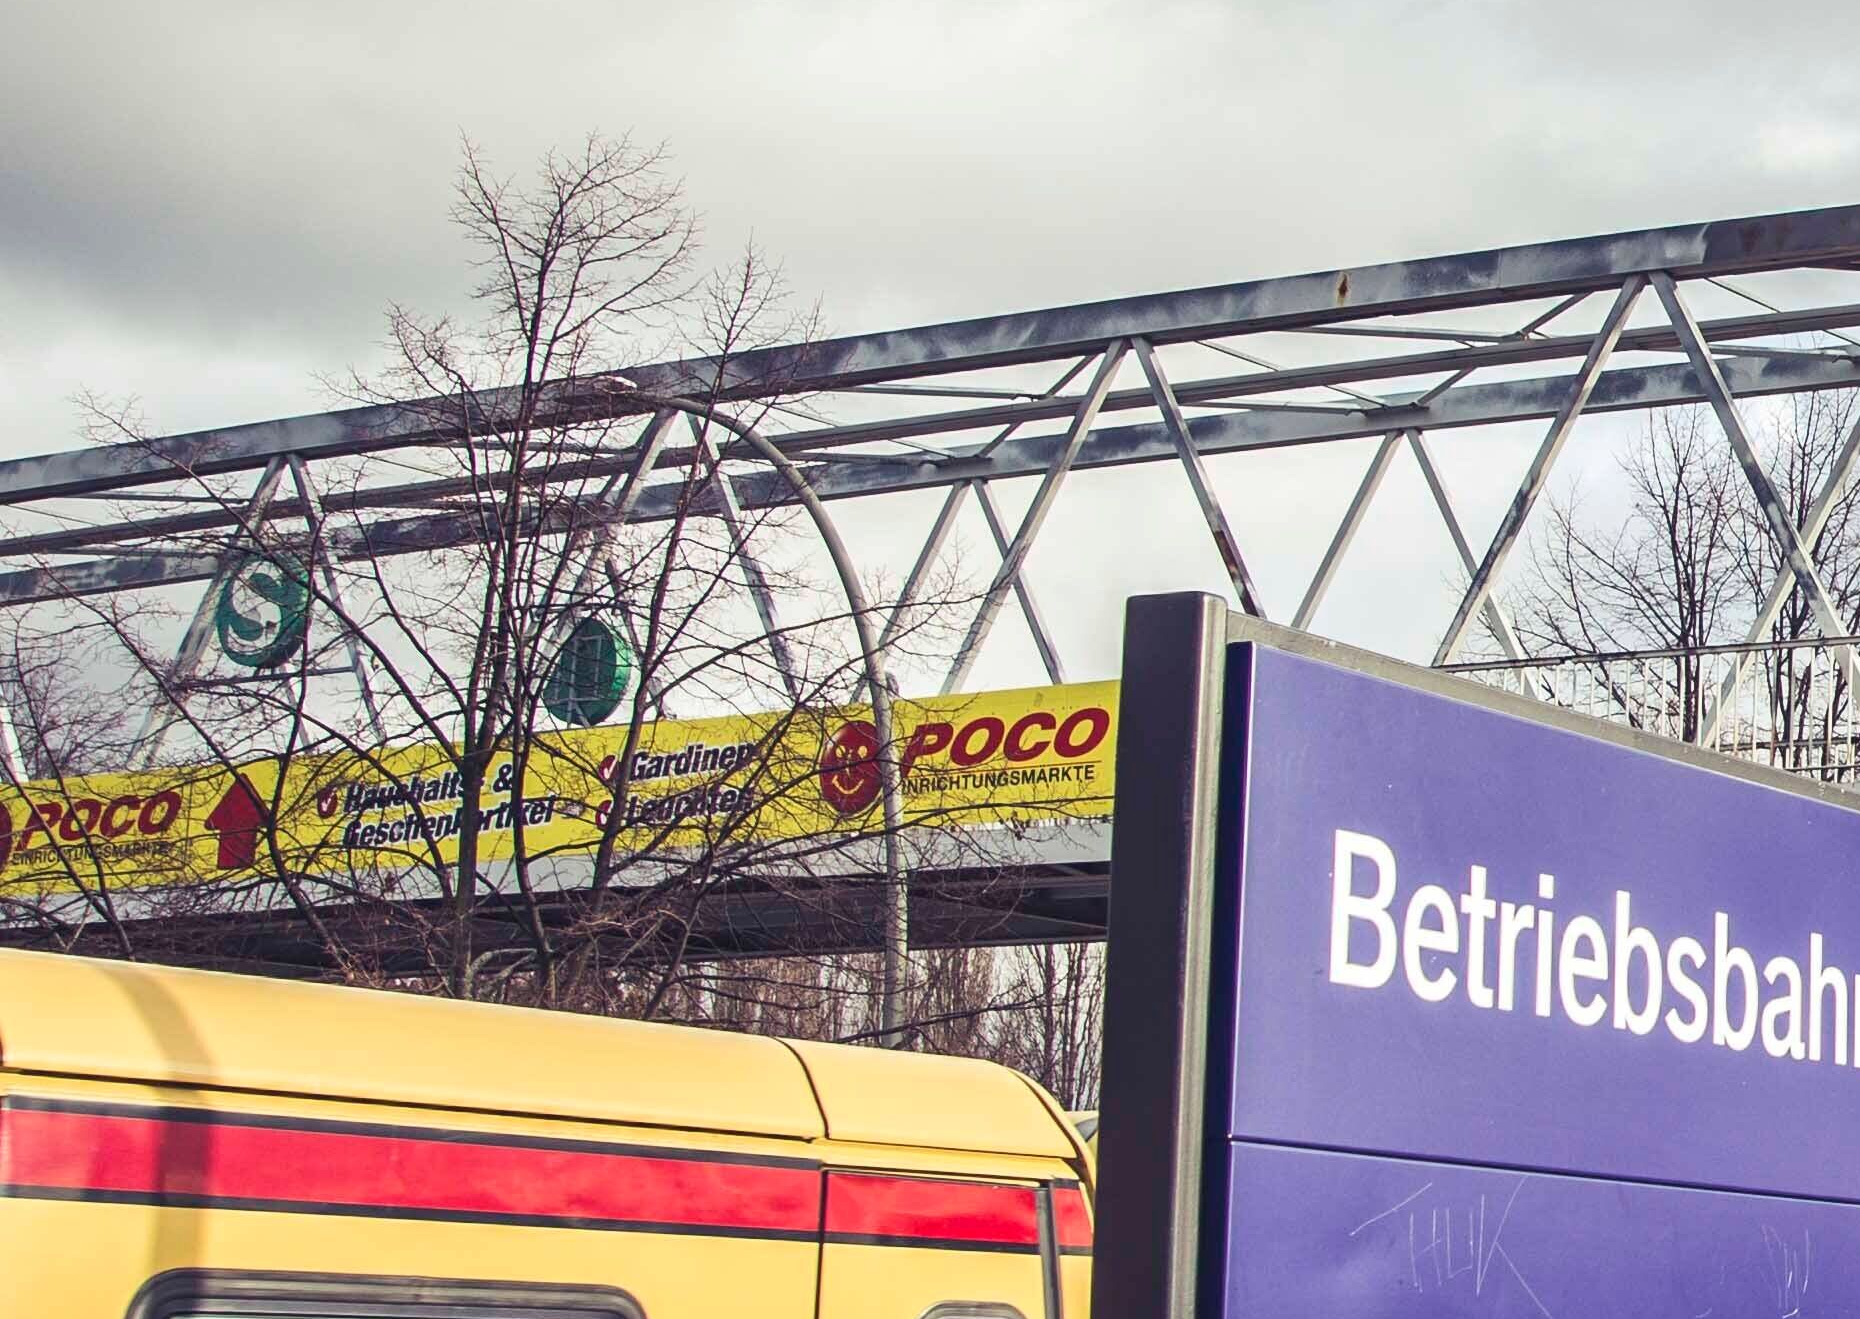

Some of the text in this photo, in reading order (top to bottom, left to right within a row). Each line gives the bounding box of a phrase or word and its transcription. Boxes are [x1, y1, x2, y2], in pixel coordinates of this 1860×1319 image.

[901, 706, 1110, 778] POCO
[899, 764, 1095, 794] INRICHTUNGSMÄRKTE
[15, 791, 182, 852] POCO
